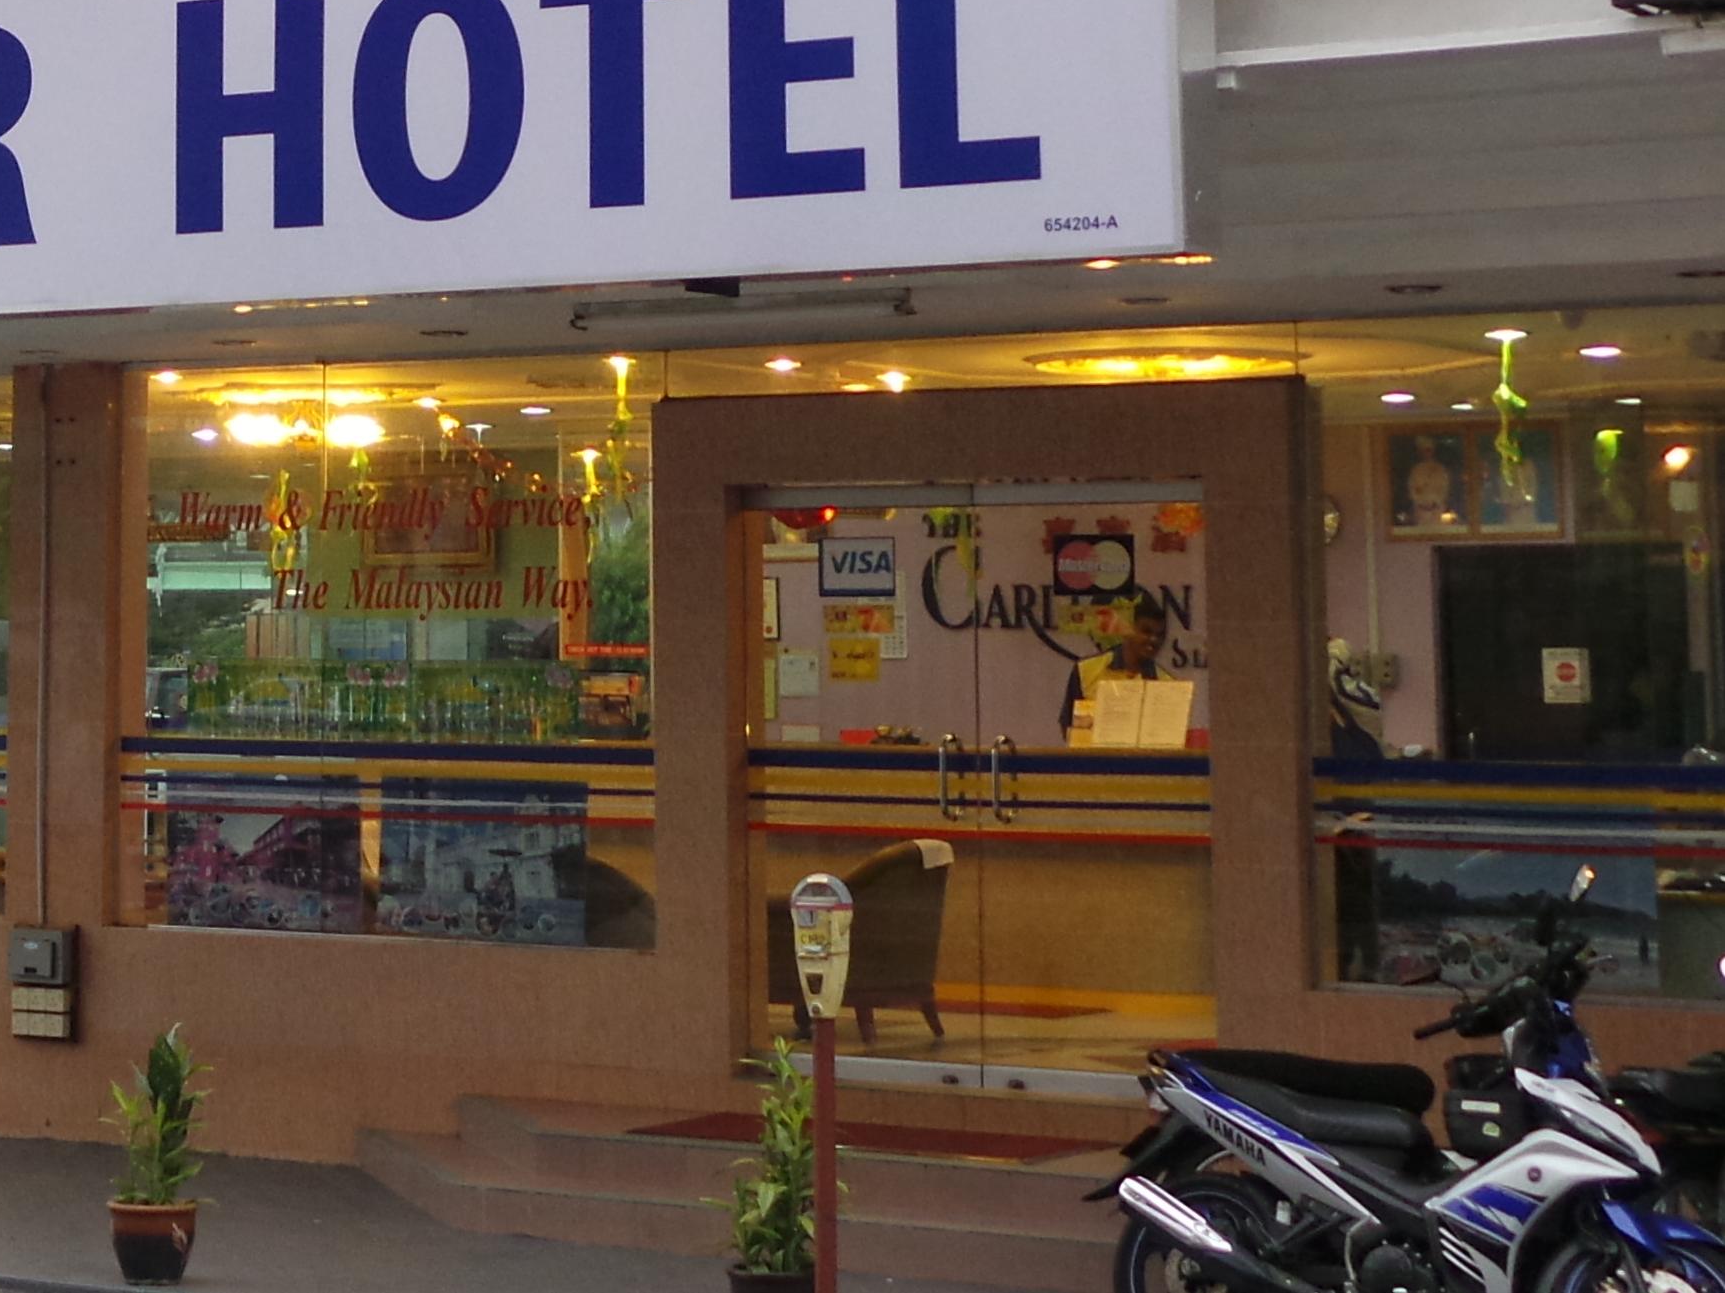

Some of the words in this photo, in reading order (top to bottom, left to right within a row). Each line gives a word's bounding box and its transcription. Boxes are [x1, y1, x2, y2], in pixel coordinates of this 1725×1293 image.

[1043, 214, 1118, 233] 654204-A
[180, 491, 263, 531] Warm
[278, 489, 300, 531] &
[319, 488, 444, 540] Friendly
[832, 551, 891, 574] VISA
[274, 568, 329, 609] The
[345, 565, 502, 621] Malaysian
[522, 566, 593, 620] Way.
[1204, 1109, 1266, 1167] YAMAHA
